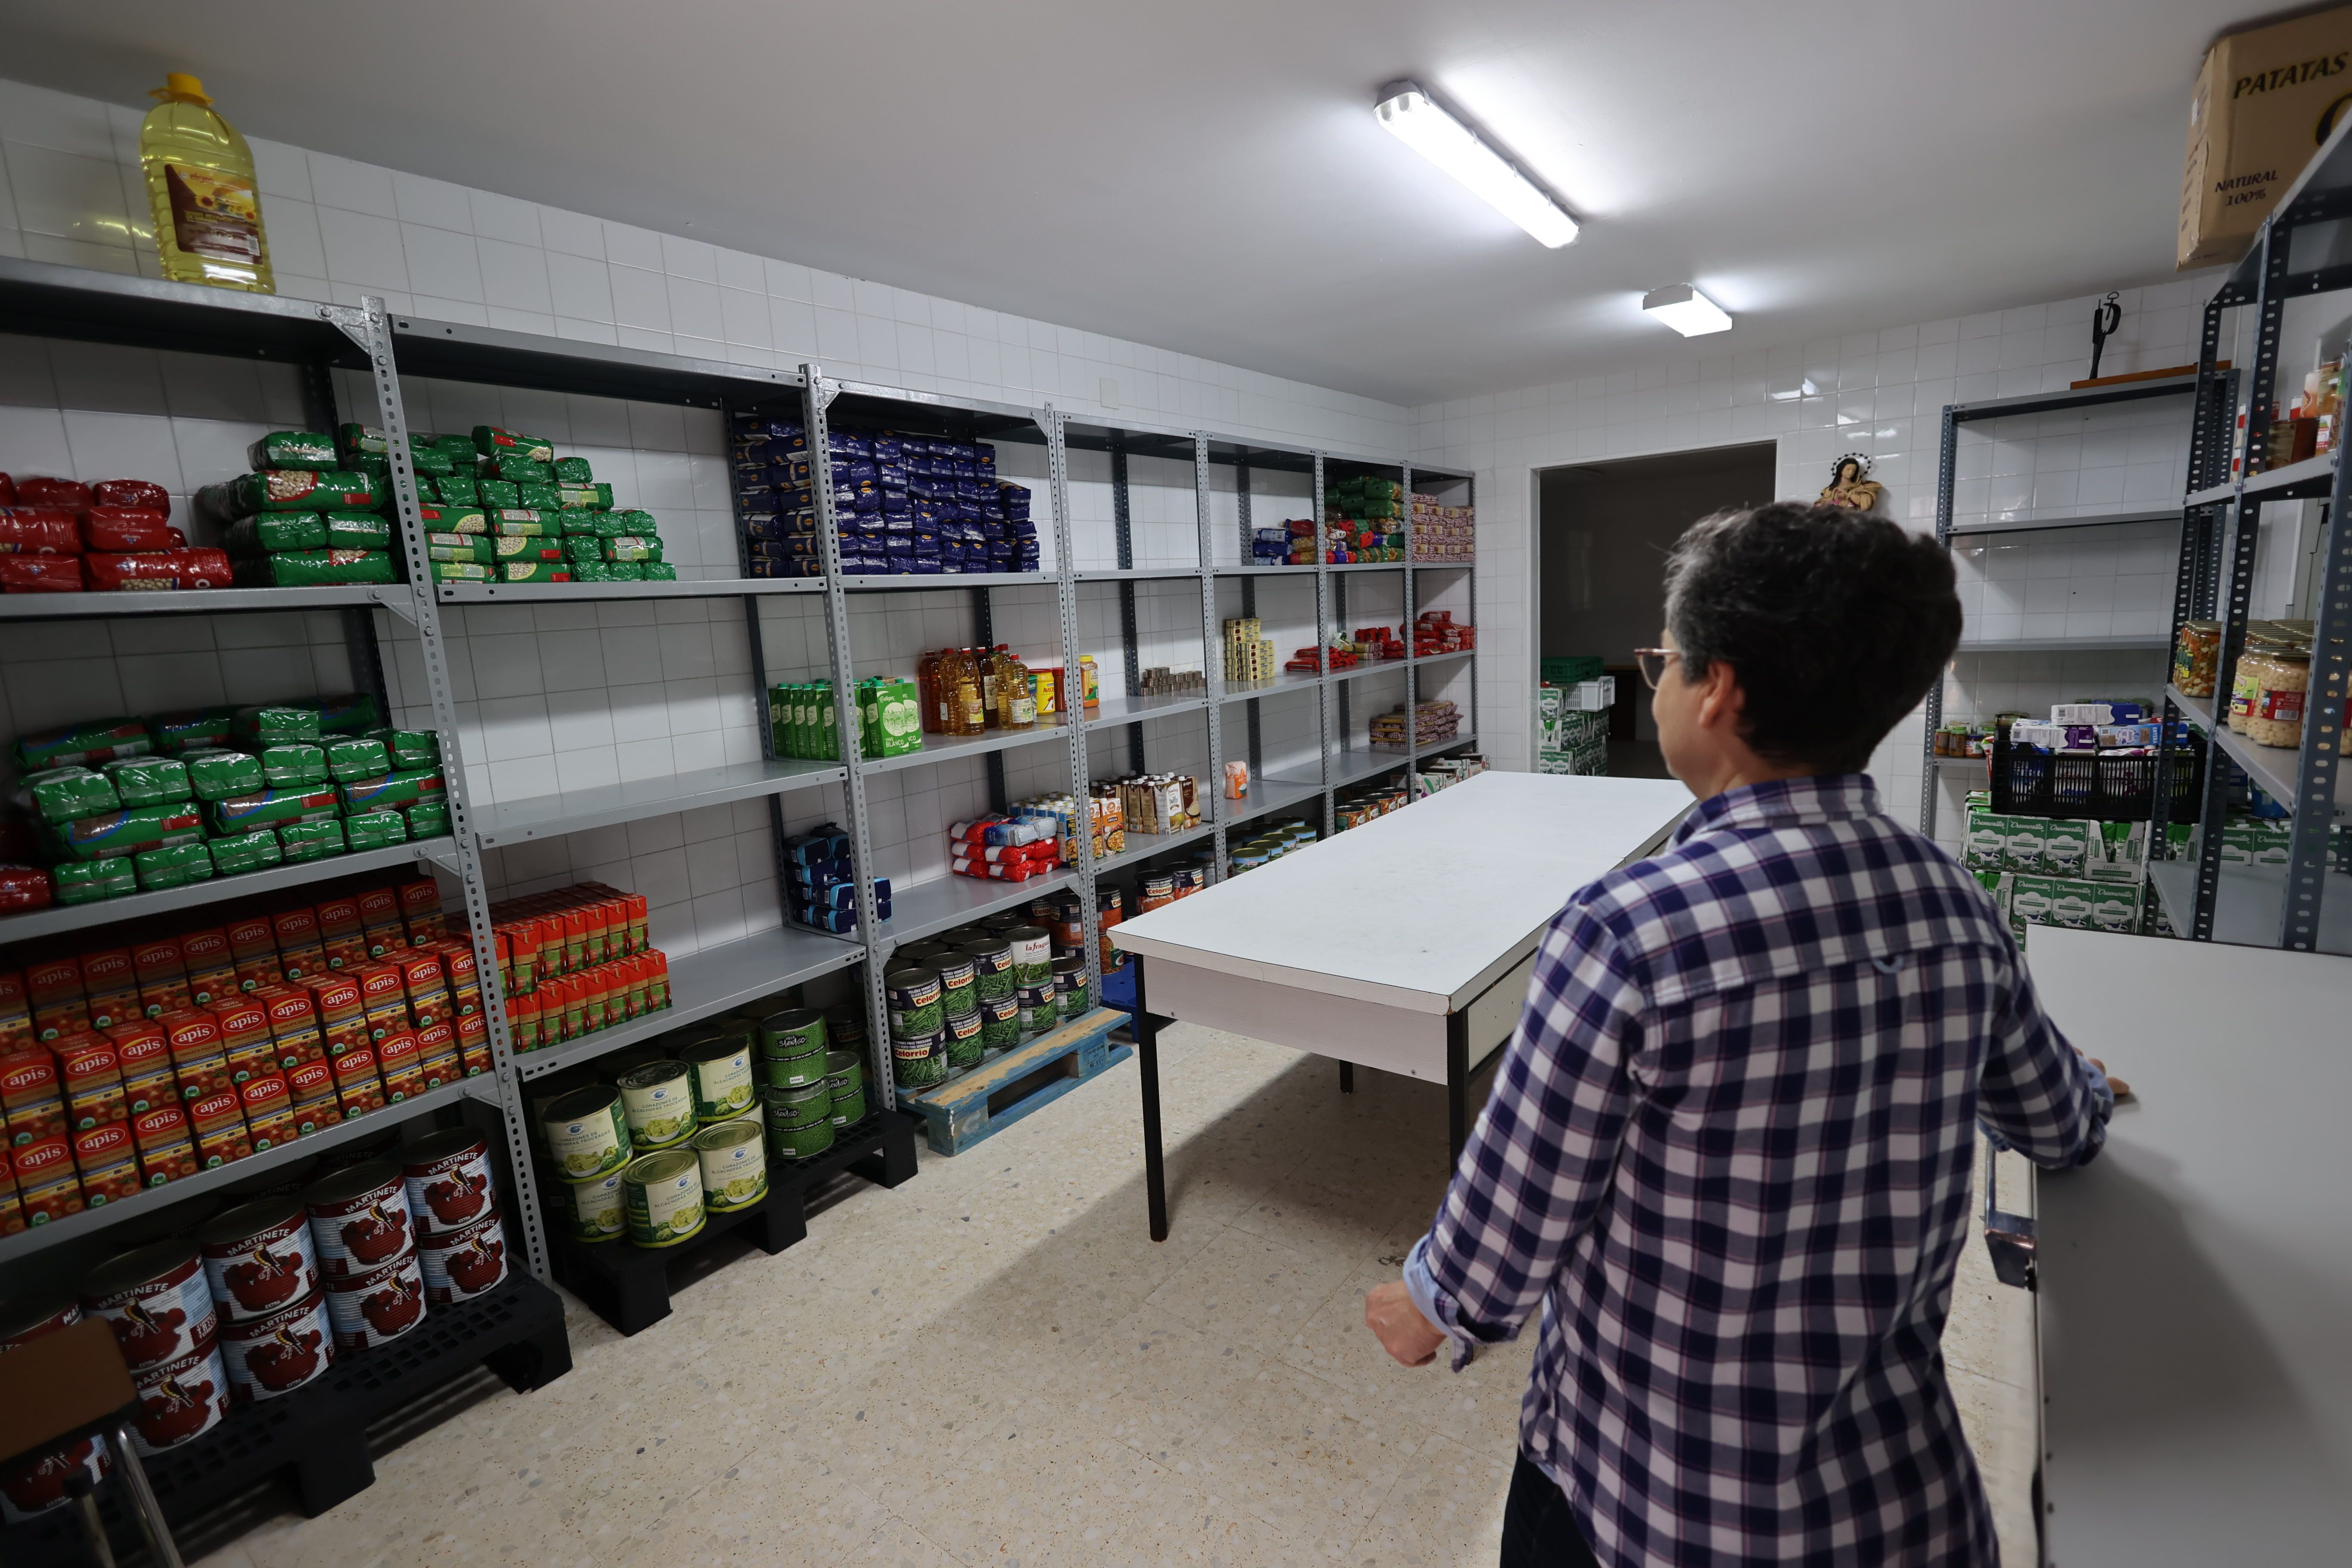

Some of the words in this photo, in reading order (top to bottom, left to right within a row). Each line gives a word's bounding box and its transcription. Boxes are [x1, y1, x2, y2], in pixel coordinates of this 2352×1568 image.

[2233, 52, 2348, 99] PATATAS
[2215, 170, 2278, 193] NATURAL
[2226, 190, 2266, 206] 100%
[886, 739, 904, 747] BLANCO
[1973, 818, 2005, 827] Cremosita
[2011, 821, 2044, 830] Cremosita
[2050, 824, 2084, 833] Cremosita
[2018, 880, 2050, 890] Cremosita
[2058, 884, 2091, 894] Cremosita
[410, 887, 432, 899] apis
[2098, 888, 2133, 897] Cremosita
[367, 896, 391, 909] apis
[325, 906, 351, 920] apis
[282, 916, 309, 930] apis
[237, 926, 264, 940] apis
[191, 937, 220, 952] apis
[143, 947, 173, 963] apis
[93, 958, 124, 973] apis
[413, 963, 437, 979] apis
[38, 968, 71, 984] apis
[948, 973, 974, 987] Celorrio
[370, 976, 395, 991] apis
[328, 989, 354, 1004] apis
[277, 1001, 306, 1016] apis
[230, 1014, 259, 1029] apis
[465, 1017, 487, 1031] apis
[179, 1026, 210, 1042] apis
[423, 1027, 447, 1041] apis
[129, 1039, 160, 1056] apis
[387, 1039, 411, 1054] apis
[778, 1038, 805, 1047] SARNAGO
[75, 1055, 109, 1072] apis
[342, 1053, 368, 1068] apis
[10, 1069, 46, 1086] apis
[295, 1068, 323, 1084] apis
[714, 1073, 741, 1084] ALCACHOFAS
[250, 1081, 279, 1097] apis
[830, 1079, 847, 1088] RNAGO
[200, 1097, 231, 1113] apis
[642, 1100, 671, 1109] CORAZONES
[663, 1096, 687, 1110] TROCEADAS
[145, 1112, 178, 1128] apis
[773, 1109, 798, 1117] SARNAGO
[85, 1132, 119, 1148] apis
[559, 1134, 589, 1142] CORAZONES
[581, 1130, 610, 1143] TROCEADAS
[25, 1148, 61, 1165] apis
[723, 1158, 750, 1169] CORAZONES
[428, 1152, 478, 1176] MARTINETE
[711, 1166, 742, 1174] ALCACHOFAS
[582, 1195, 614, 1204] ALCACHOFAS
[667, 1185, 692, 1200] CORAZONES
[345, 1186, 398, 1214] MARTINETE
[655, 1195, 686, 1208] ALCACHOFAS
[458, 1215, 471, 1223] EXTRA
[450, 1219, 496, 1246] MARTINETE
[227, 1228, 290, 1257] MARTINETE
[379, 1253, 393, 1262] EXTRA
[366, 1255, 413, 1286] MARTINETE
[480, 1283, 491, 1291] EXTRA
[98, 1283, 168, 1309] MARTINETE
[265, 1300, 281, 1309] EXTRA
[250, 1306, 310, 1338] MARTINETE
[398, 1323, 410, 1332] EXTRA
[138, 1359, 156, 1369] EXTRA
[135, 1355, 200, 1389] MARTINETE
[286, 1378, 302, 1388] EXTRA
[173, 1433, 190, 1444] EXTRA
